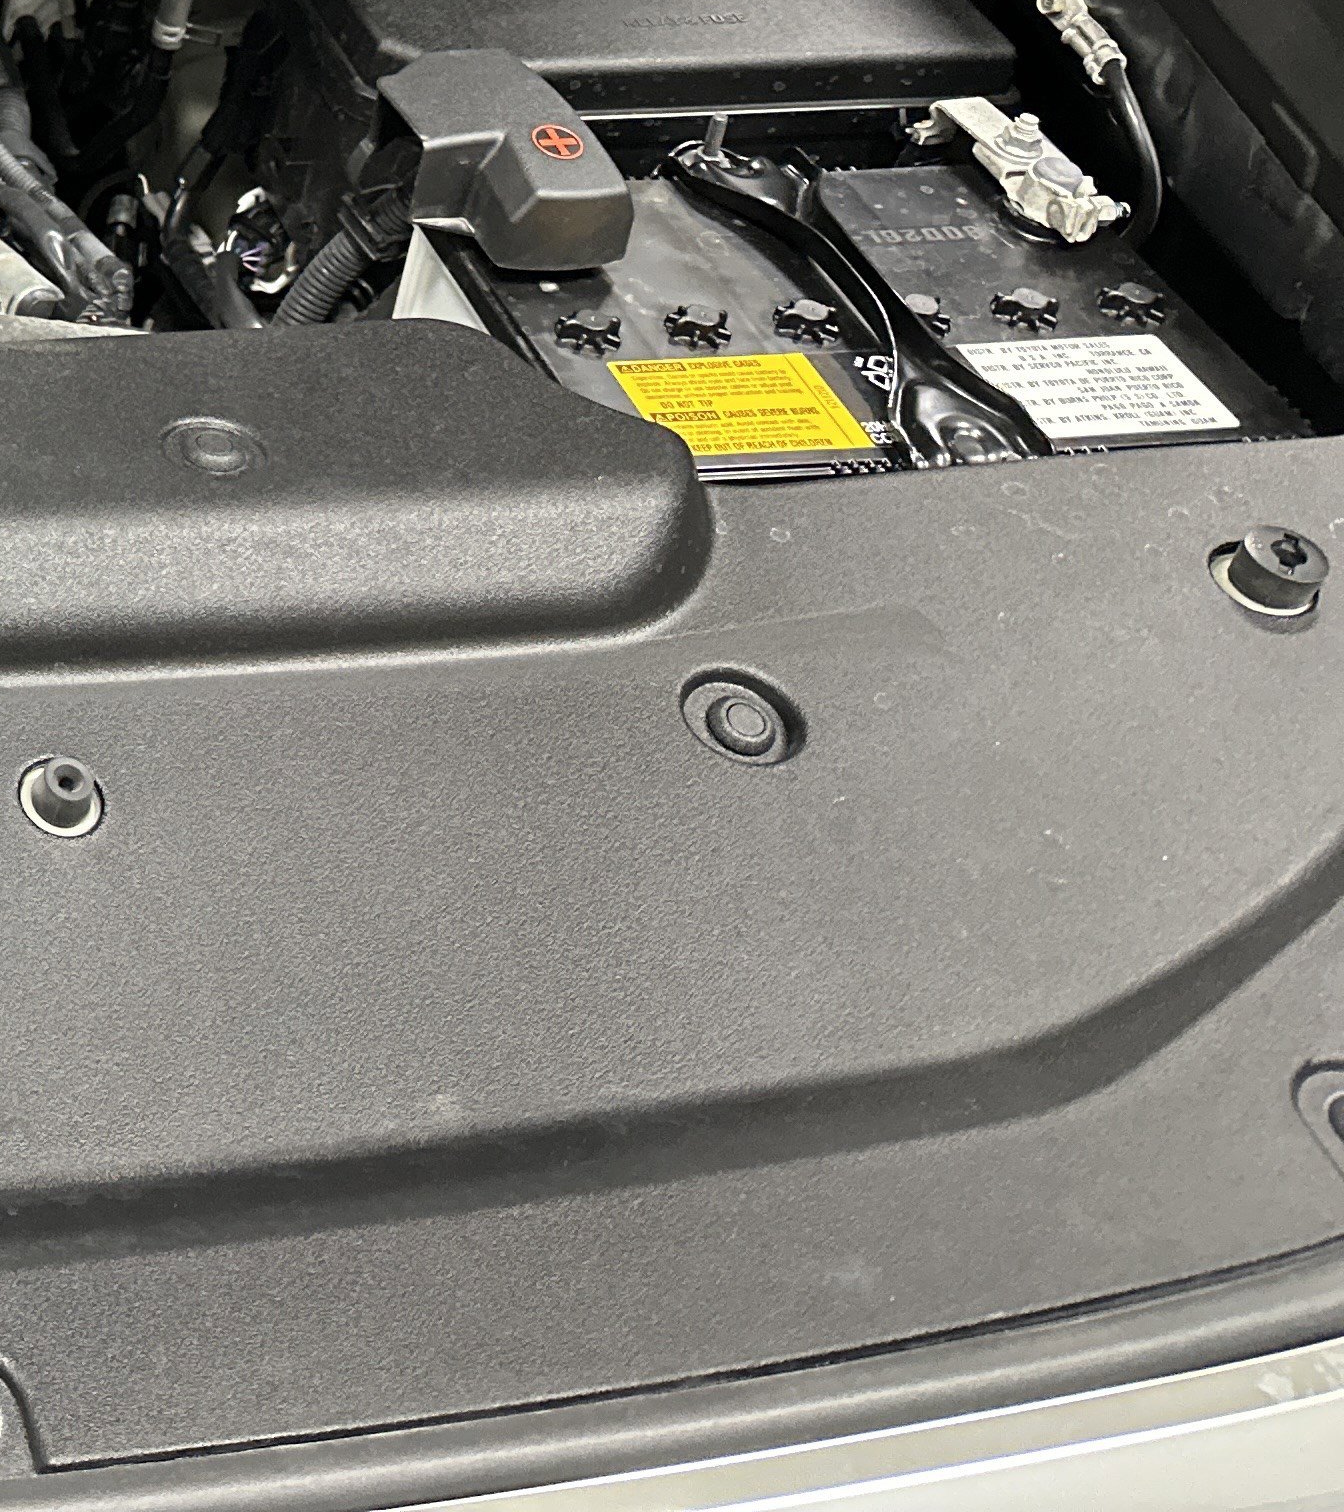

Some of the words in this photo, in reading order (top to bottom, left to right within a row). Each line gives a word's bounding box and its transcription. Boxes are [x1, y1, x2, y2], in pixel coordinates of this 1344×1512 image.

[698, 12, 750, 26] FUSE
[1015, 345, 1049, 354] TOYOTA
[1050, 342, 1082, 350] MOTOR
[1082, 341, 1111, 349] SALES
[629, 362, 684, 374] DANGER
[688, 361, 732, 370] EXPLOSIVE
[732, 359, 762, 368] GASES
[1042, 378, 1077, 387] TOYOTA
[660, 401, 675, 410] DO
[677, 400, 696, 409] NOT
[698, 399, 714, 408] TIP
[666, 412, 718, 422] POISON
[723, 409, 758, 419] CAUSES
[760, 408, 789, 417] SEVERE
[791, 406, 821, 415] BURNS
[692, 443, 714, 452] KEEP
[715, 442, 732, 451] OUT
[733, 442, 746, 450] OF
[746, 441, 776, 449] REACH
[776, 440, 789, 448] OF
[791, 438, 834, 448] CHILDREN
